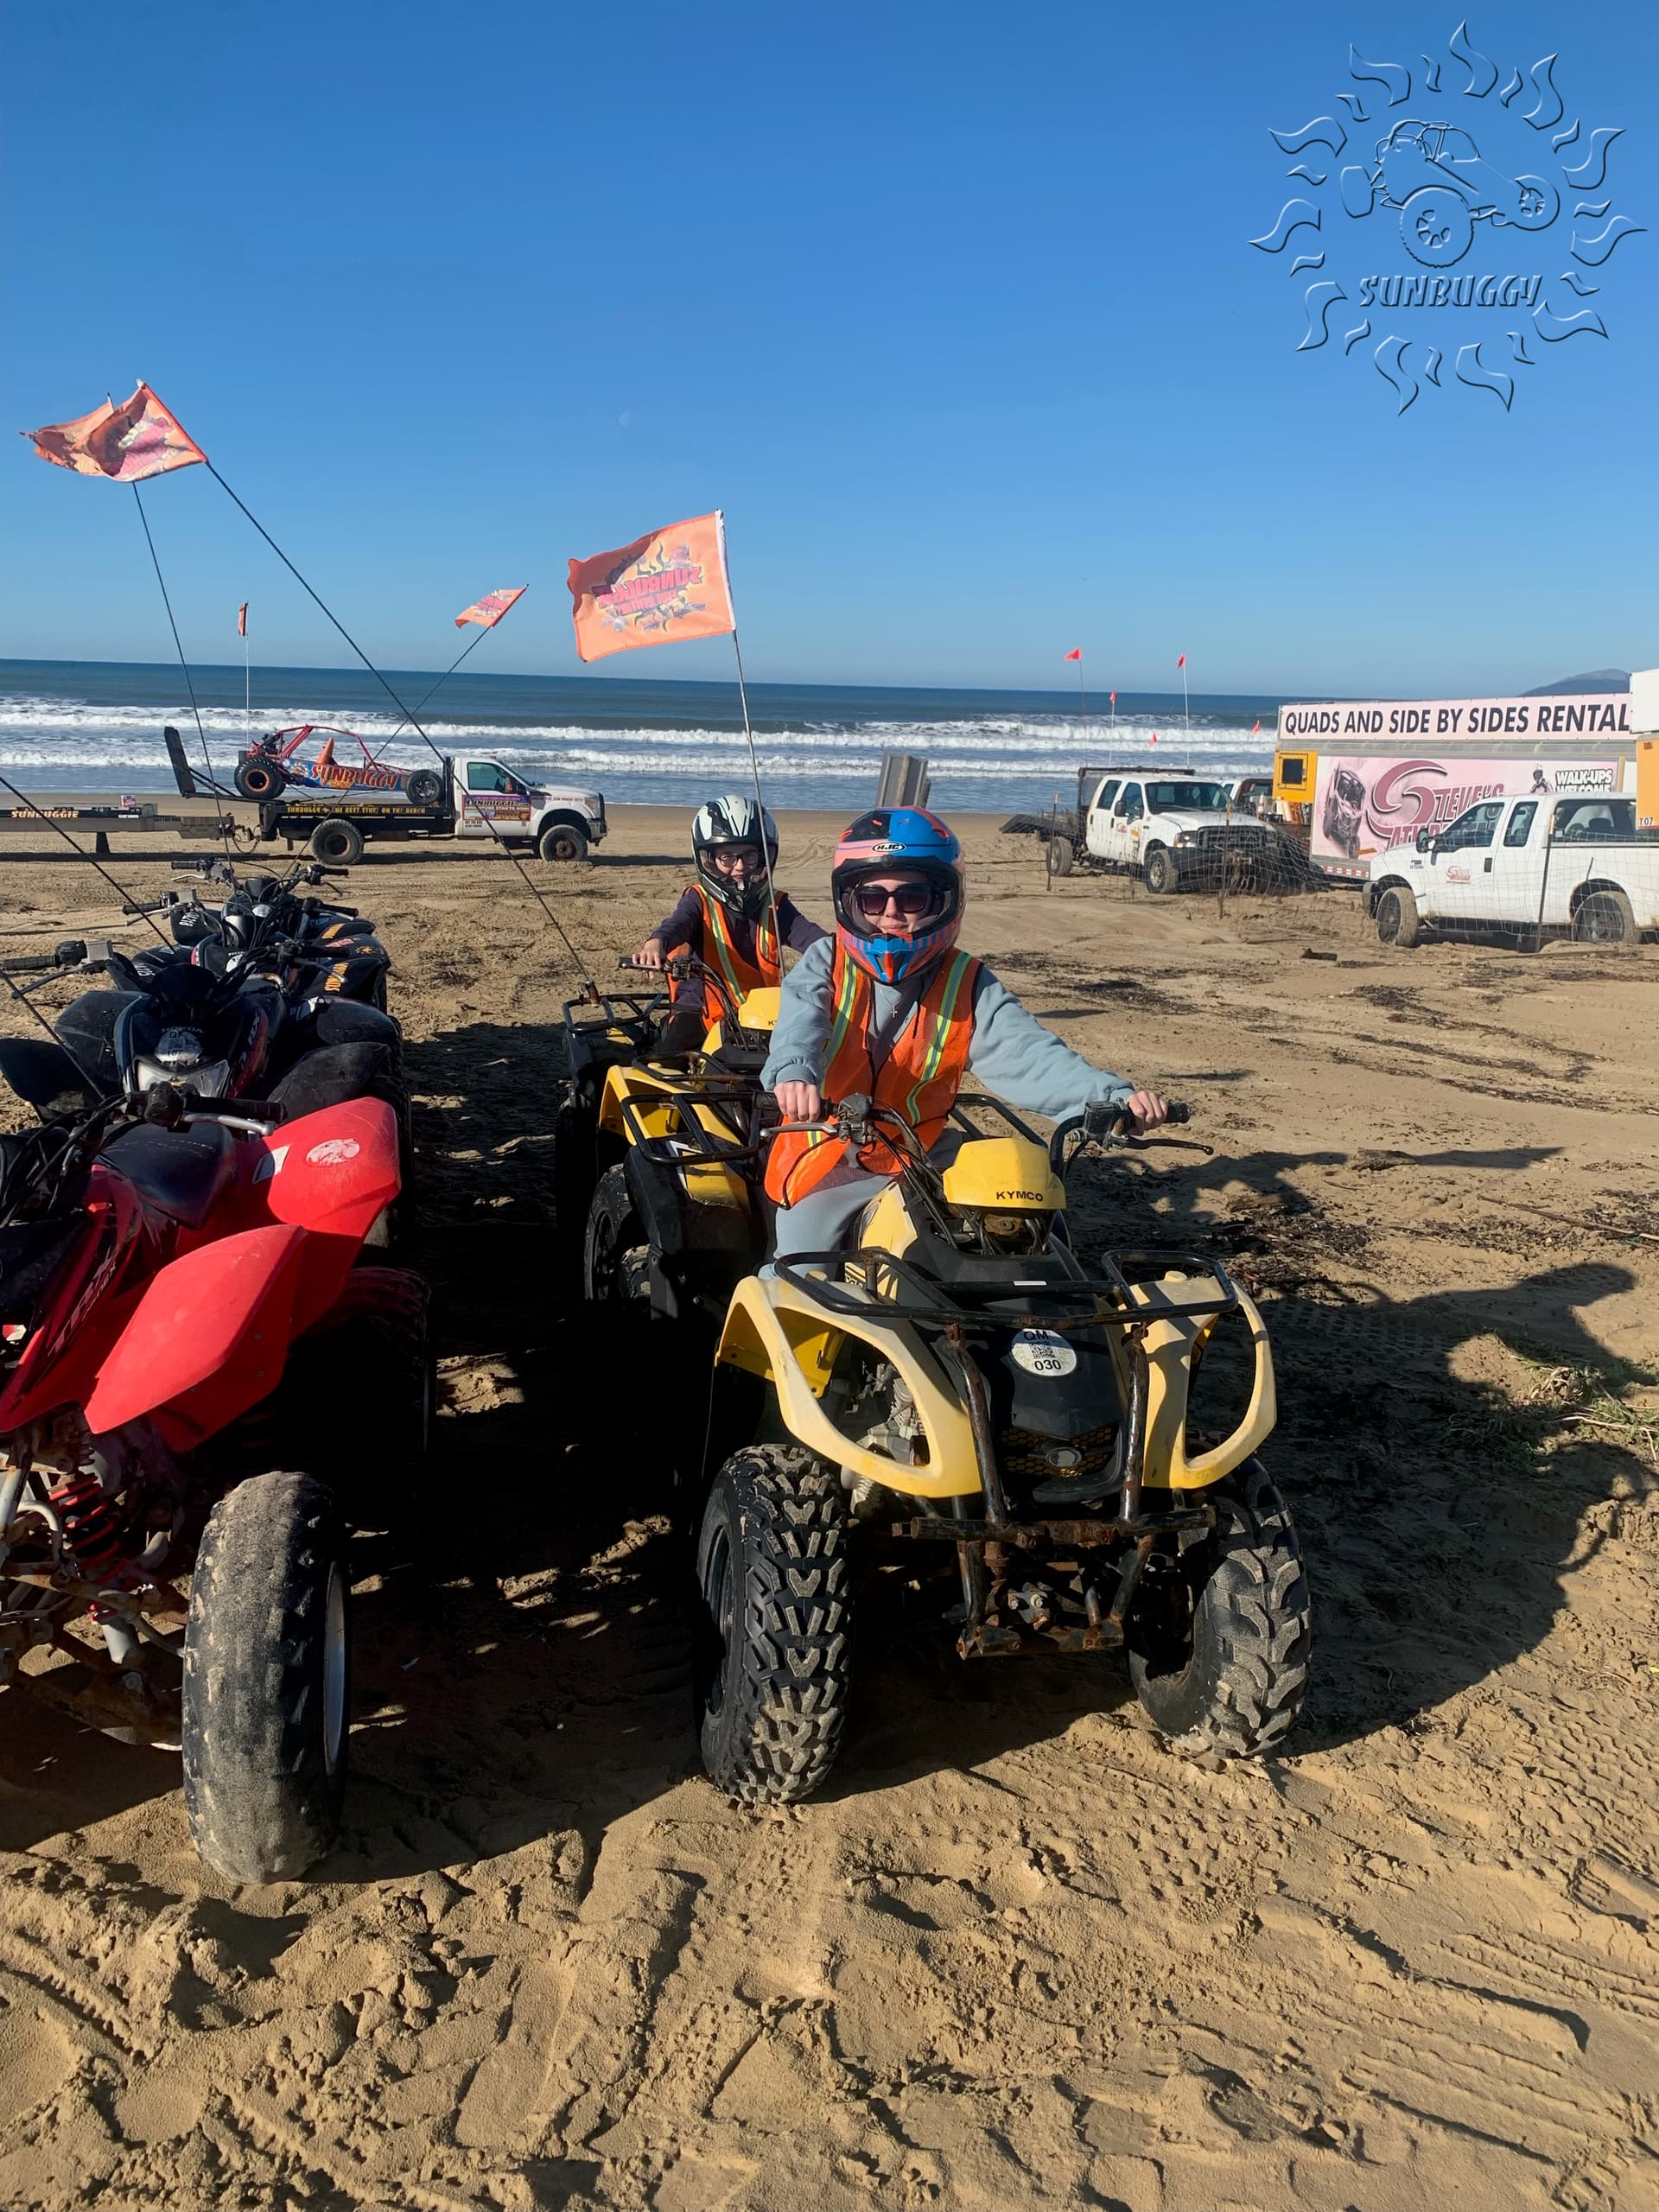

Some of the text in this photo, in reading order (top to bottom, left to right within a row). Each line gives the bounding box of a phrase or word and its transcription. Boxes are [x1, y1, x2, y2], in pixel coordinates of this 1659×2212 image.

[1285, 703, 1630, 735] QUADS AND SIDE BY SIDES RENTAL
[311, 764, 397, 789] SUNBUGGY
[1555, 768, 1613, 785] WALK-UPS
[996, 1191, 1044, 1202] KYMCO
[1023, 1330, 1050, 1340] QM
[1034, 1359, 1062, 1370] 030
